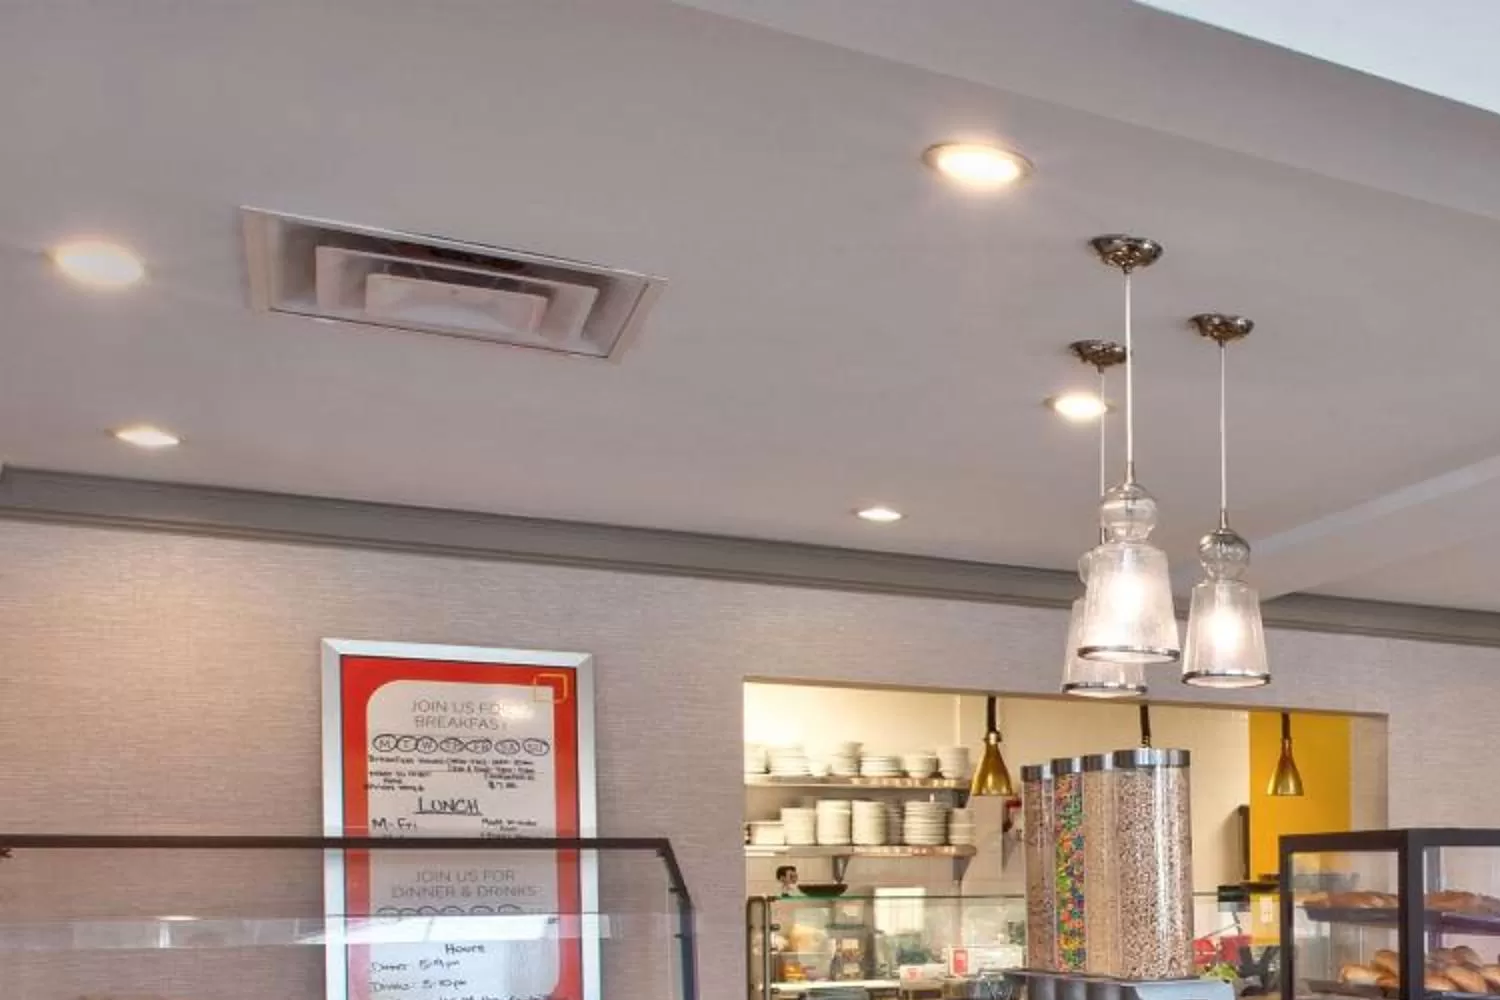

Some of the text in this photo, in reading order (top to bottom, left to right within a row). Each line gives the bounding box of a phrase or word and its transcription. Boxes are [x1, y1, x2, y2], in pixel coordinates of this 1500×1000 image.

[411, 700, 448, 713] JOIN
[452, 701, 475, 714] US
[417, 797, 481, 814] LUNCH
[416, 869, 514, 882] JOIN US FOR
[391, 885, 455, 898] DINNER
[476, 885, 537, 897] DRINKS
